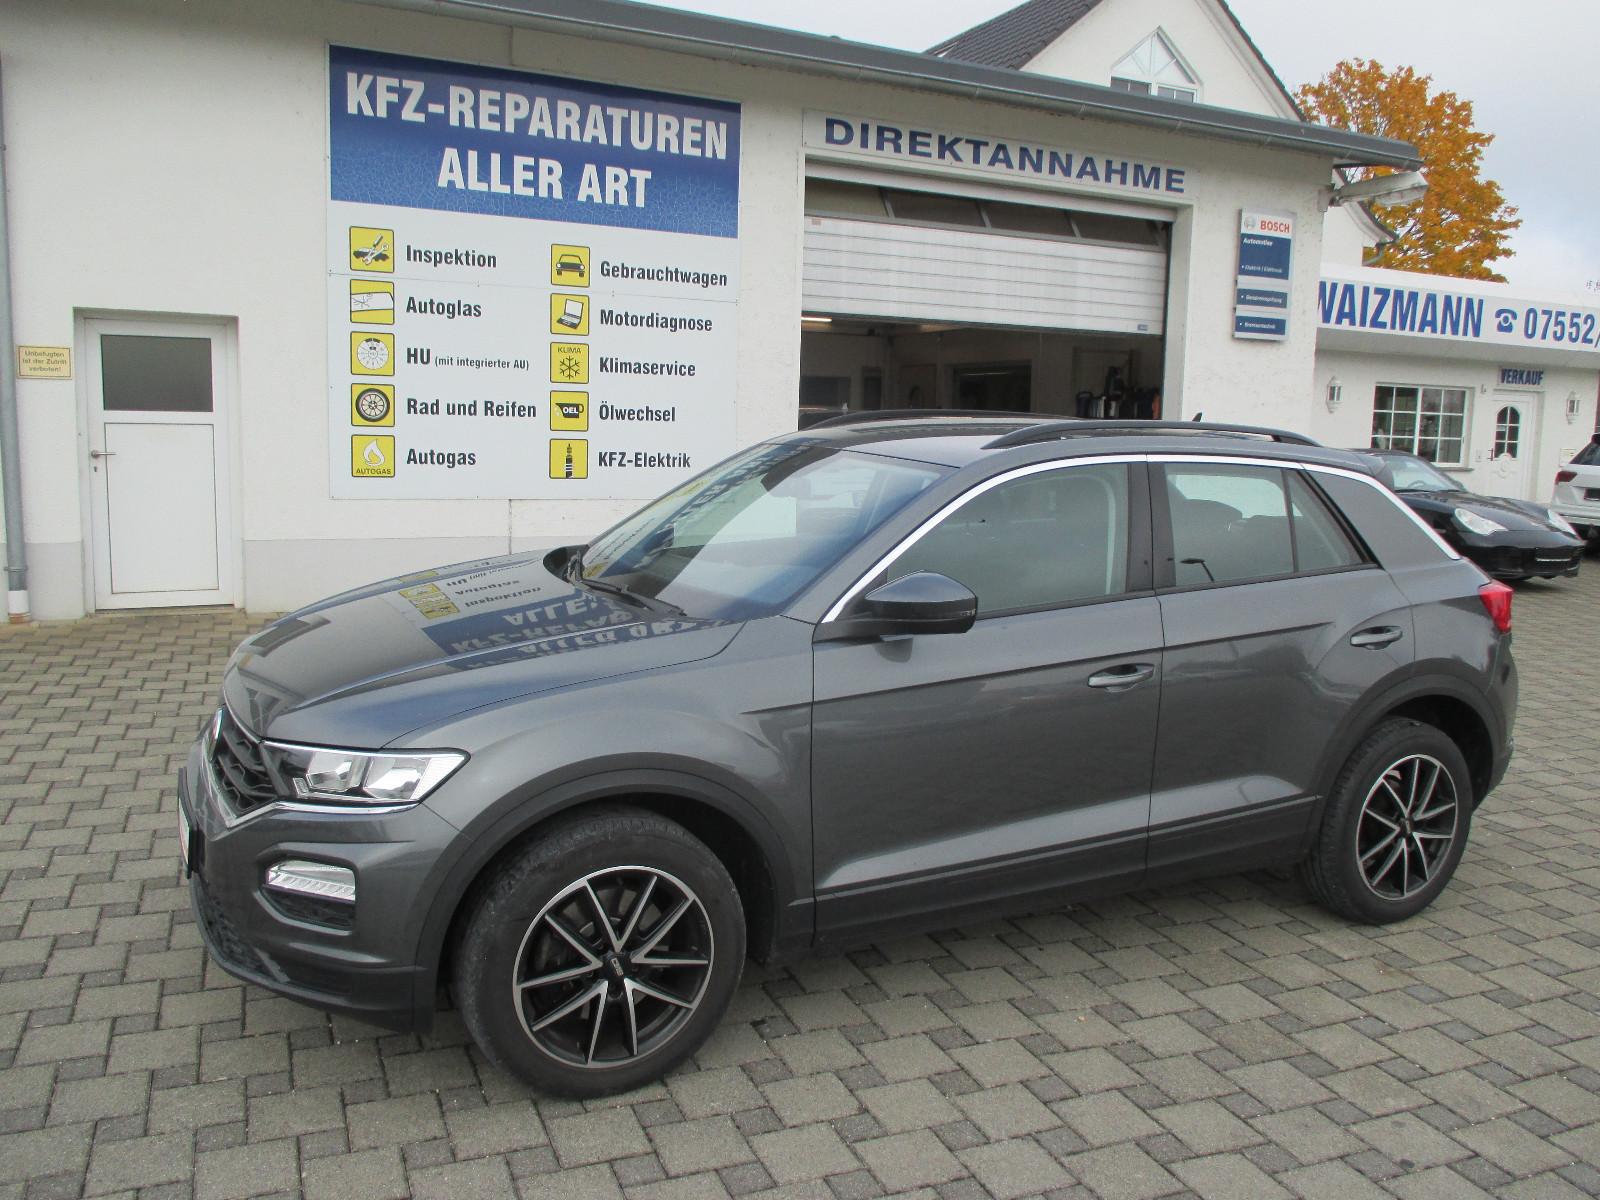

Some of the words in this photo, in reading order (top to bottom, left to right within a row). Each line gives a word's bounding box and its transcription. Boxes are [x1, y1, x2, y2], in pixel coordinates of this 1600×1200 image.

[346, 71, 728, 160] KFZ-REPARATUREN
[825, 117, 1186, 194] DIREKTANNAHME
[437, 147, 564, 200] ALLER
[577, 163, 653, 208] ART
[1260, 220, 1290, 233] BOSCH
[406, 244, 498, 269] Inspektion
[600, 260, 728, 289] Gebrauchtwagen
[406, 296, 482, 319] Autoglas
[600, 309, 713, 333] Motordiagnose
[406, 347, 431, 366] HU
[435, 356, 454, 368] (mit
[456, 356, 511, 370] integrierter
[513, 359, 530, 371] AU)
[599, 357, 696, 377] Klimaservice
[1501, 368, 1544, 385] VERKAUF
[406, 397, 441, 416] Rad
[446, 399, 478, 417] und
[484, 400, 537, 418] Reifen
[562, 406, 579, 415] OEL
[599, 400, 676, 422] Ölwechsel
[406, 448, 477, 469] Autogas
[598, 452, 692, 469] KFZ-Elektrik
